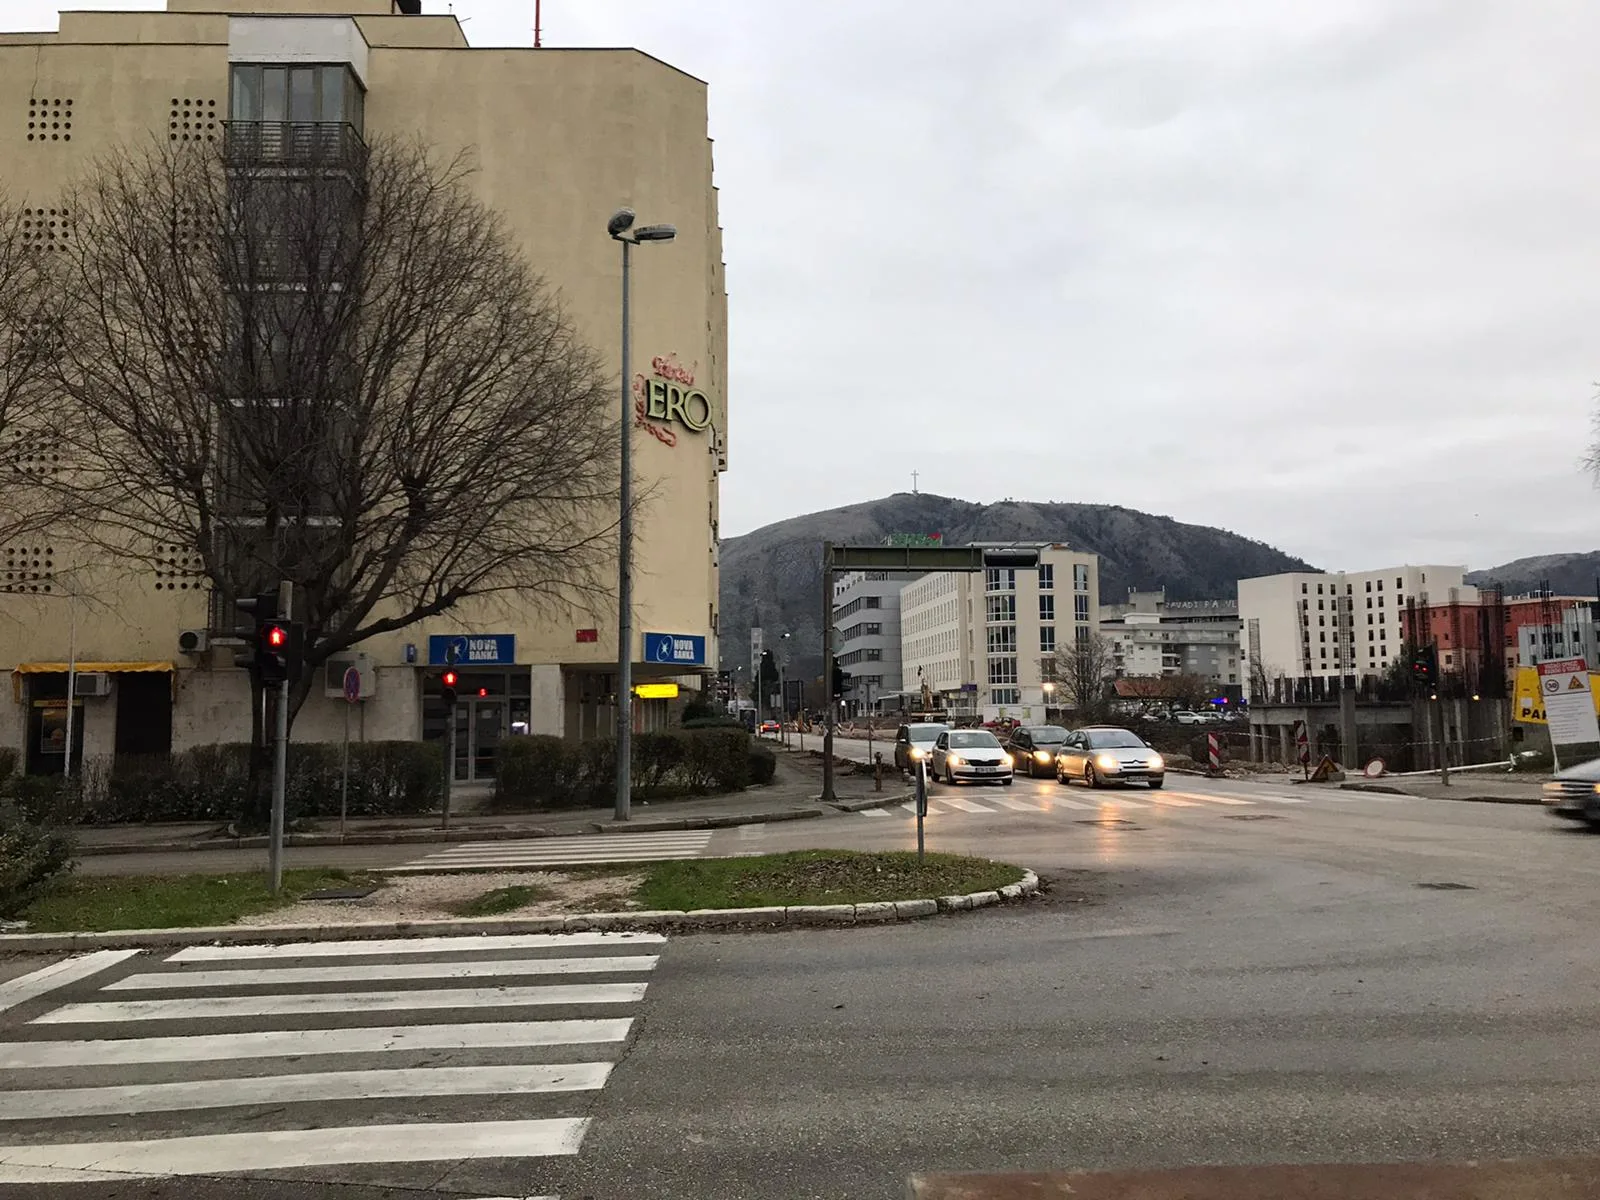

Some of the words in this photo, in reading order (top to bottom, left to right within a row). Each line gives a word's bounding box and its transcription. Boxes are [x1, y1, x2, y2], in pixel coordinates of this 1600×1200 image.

[646, 379, 712, 432] ERO
[469, 639, 497, 650] NOVA
[673, 639, 694, 650] NOVA
[469, 650, 498, 660] BANKA
[673, 650, 695, 660] BANKA
